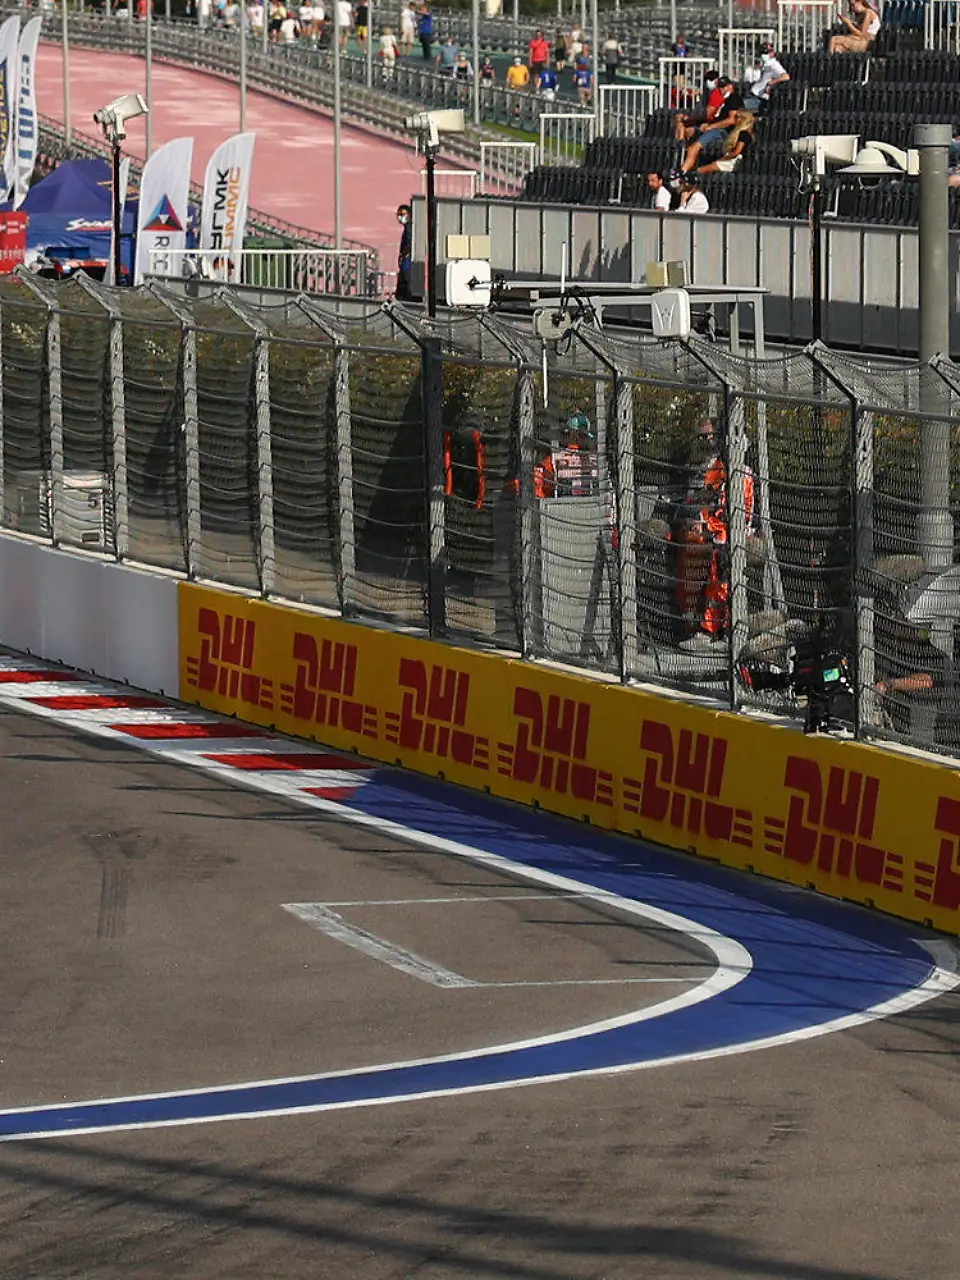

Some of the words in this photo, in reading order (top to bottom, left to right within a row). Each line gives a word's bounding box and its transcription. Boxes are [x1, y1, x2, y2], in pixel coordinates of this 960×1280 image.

[153, 235, 170, 271] RC
[197, 607, 262, 705] DHL
[293, 631, 365, 734] DHL
[398, 657, 475, 765] DHL
[512, 686, 597, 802] DHL
[640, 720, 734, 841] DHL
[783, 755, 886, 886] DHL
